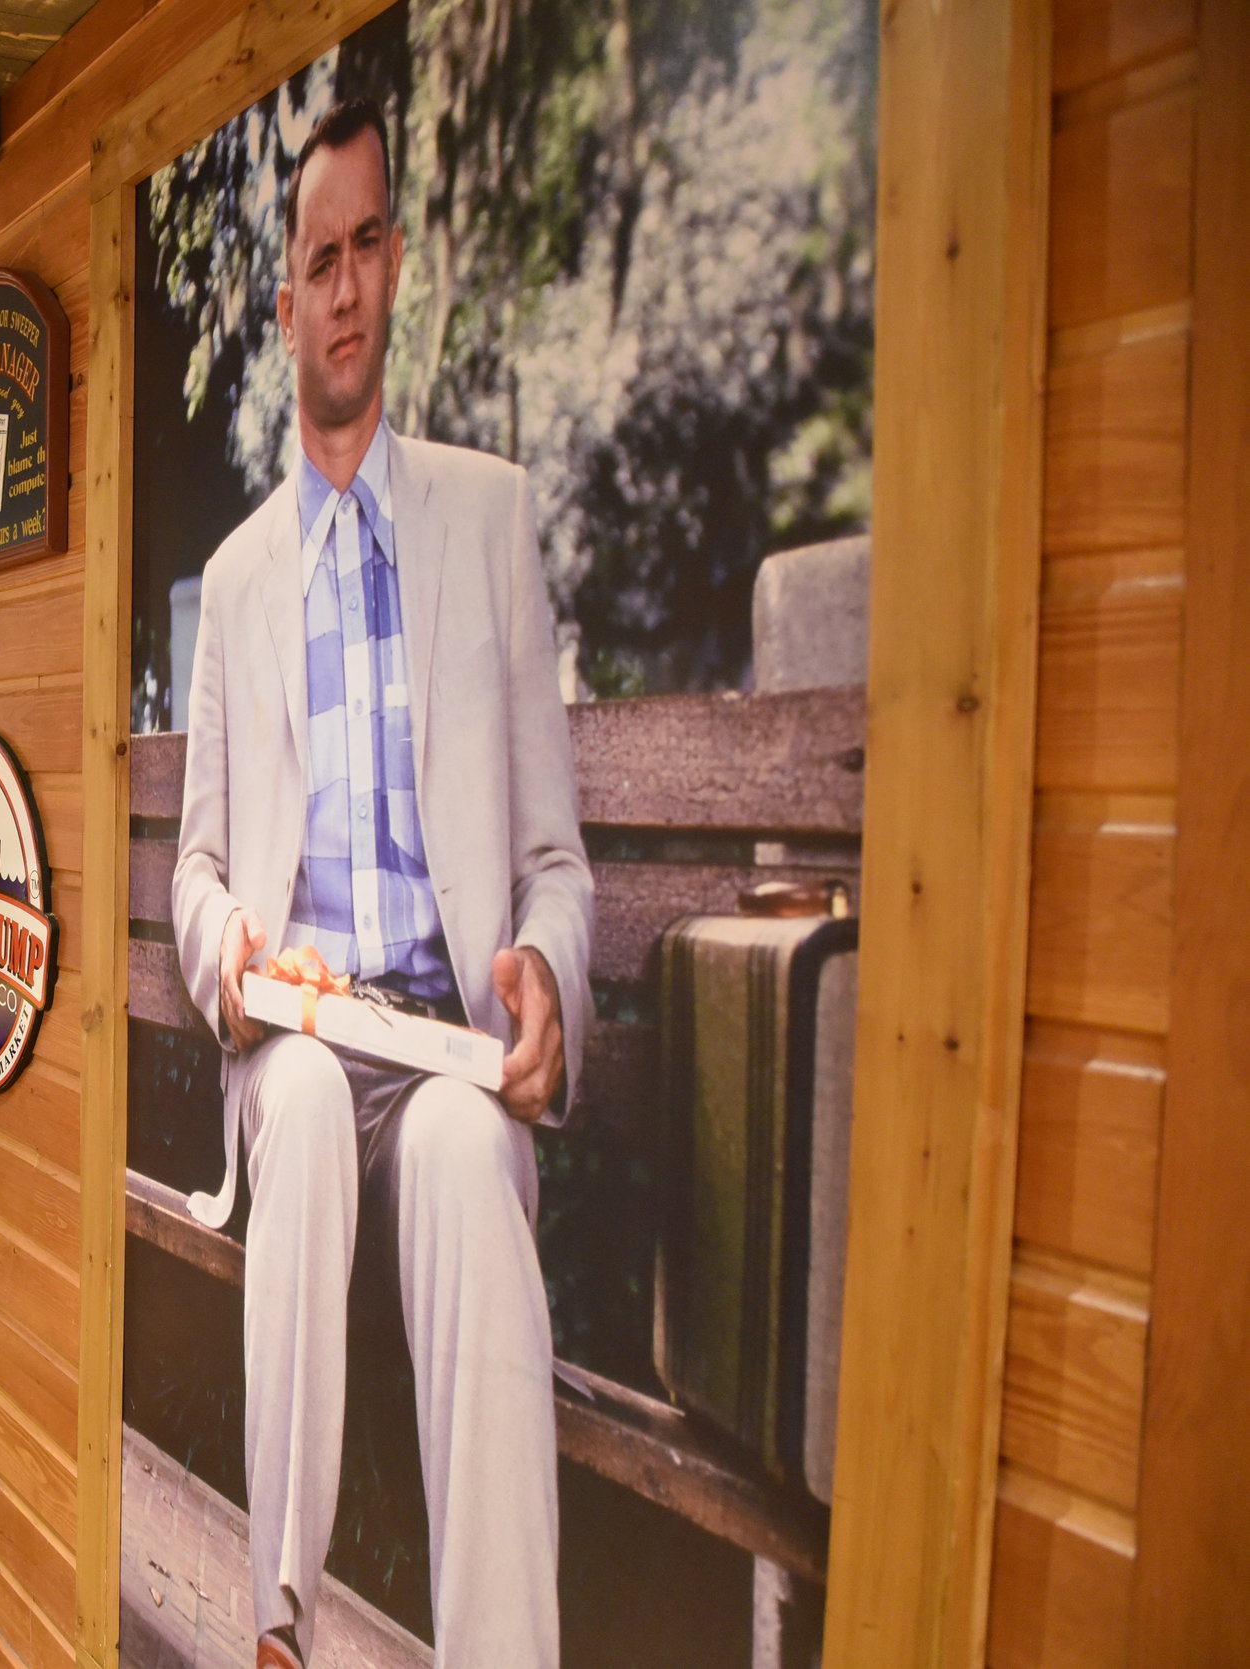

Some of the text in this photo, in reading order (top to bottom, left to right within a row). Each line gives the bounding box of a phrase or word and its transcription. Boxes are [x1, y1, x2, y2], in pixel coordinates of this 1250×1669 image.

[10, 311, 40, 348] SWEEPER
[20, 427, 38, 449] Just
[7, 445, 46, 477] blame th
[8, 473, 46, 498] compute
